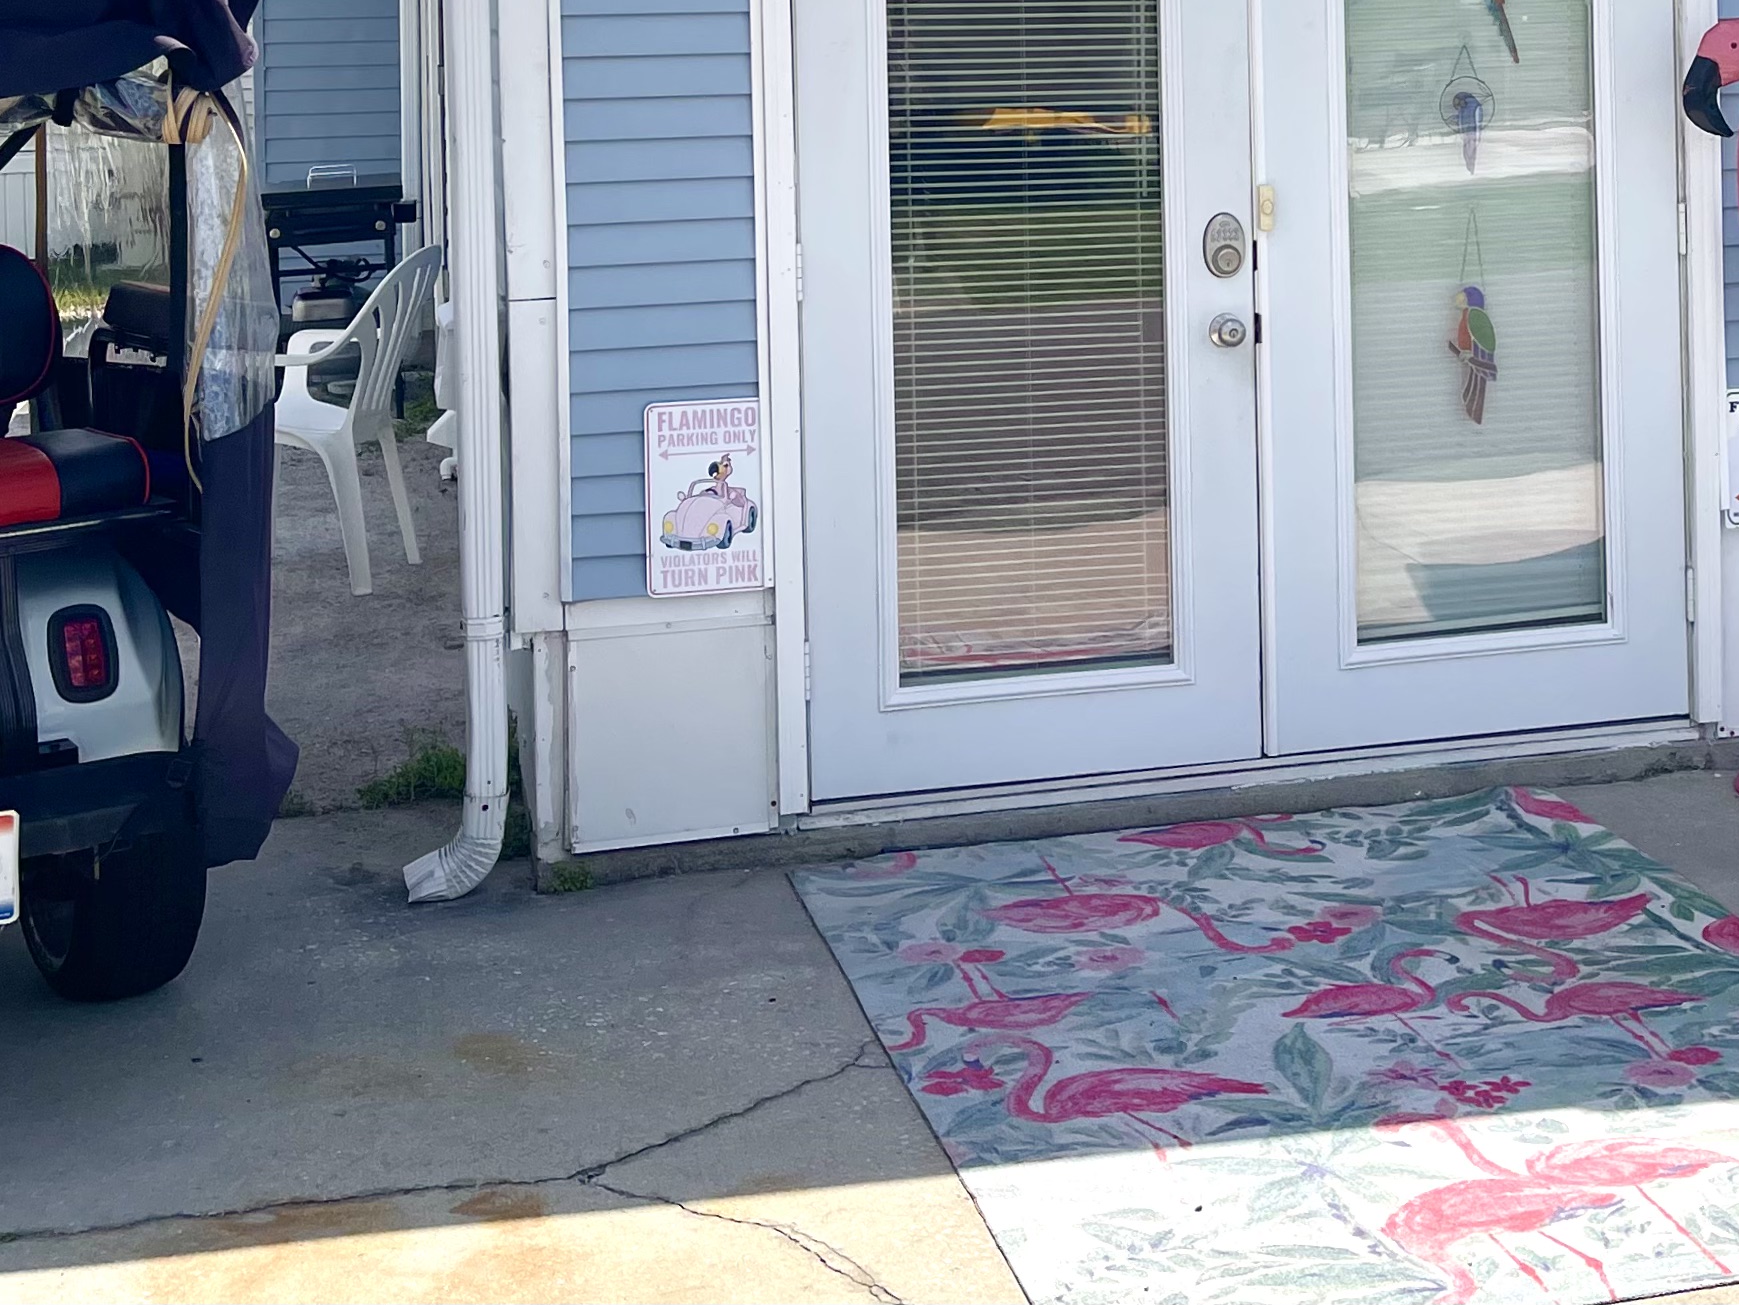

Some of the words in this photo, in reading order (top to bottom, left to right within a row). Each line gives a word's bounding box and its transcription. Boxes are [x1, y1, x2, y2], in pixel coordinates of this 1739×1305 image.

[657, 406, 757, 432] FLAMINGO
[657, 431, 719, 448] PARKING
[723, 428, 757, 444] ONLY
[660, 552, 727, 568] VIOLATORS
[731, 549, 758, 563] WILL
[661, 567, 708, 588] TURN
[715, 563, 758, 584] PINK
